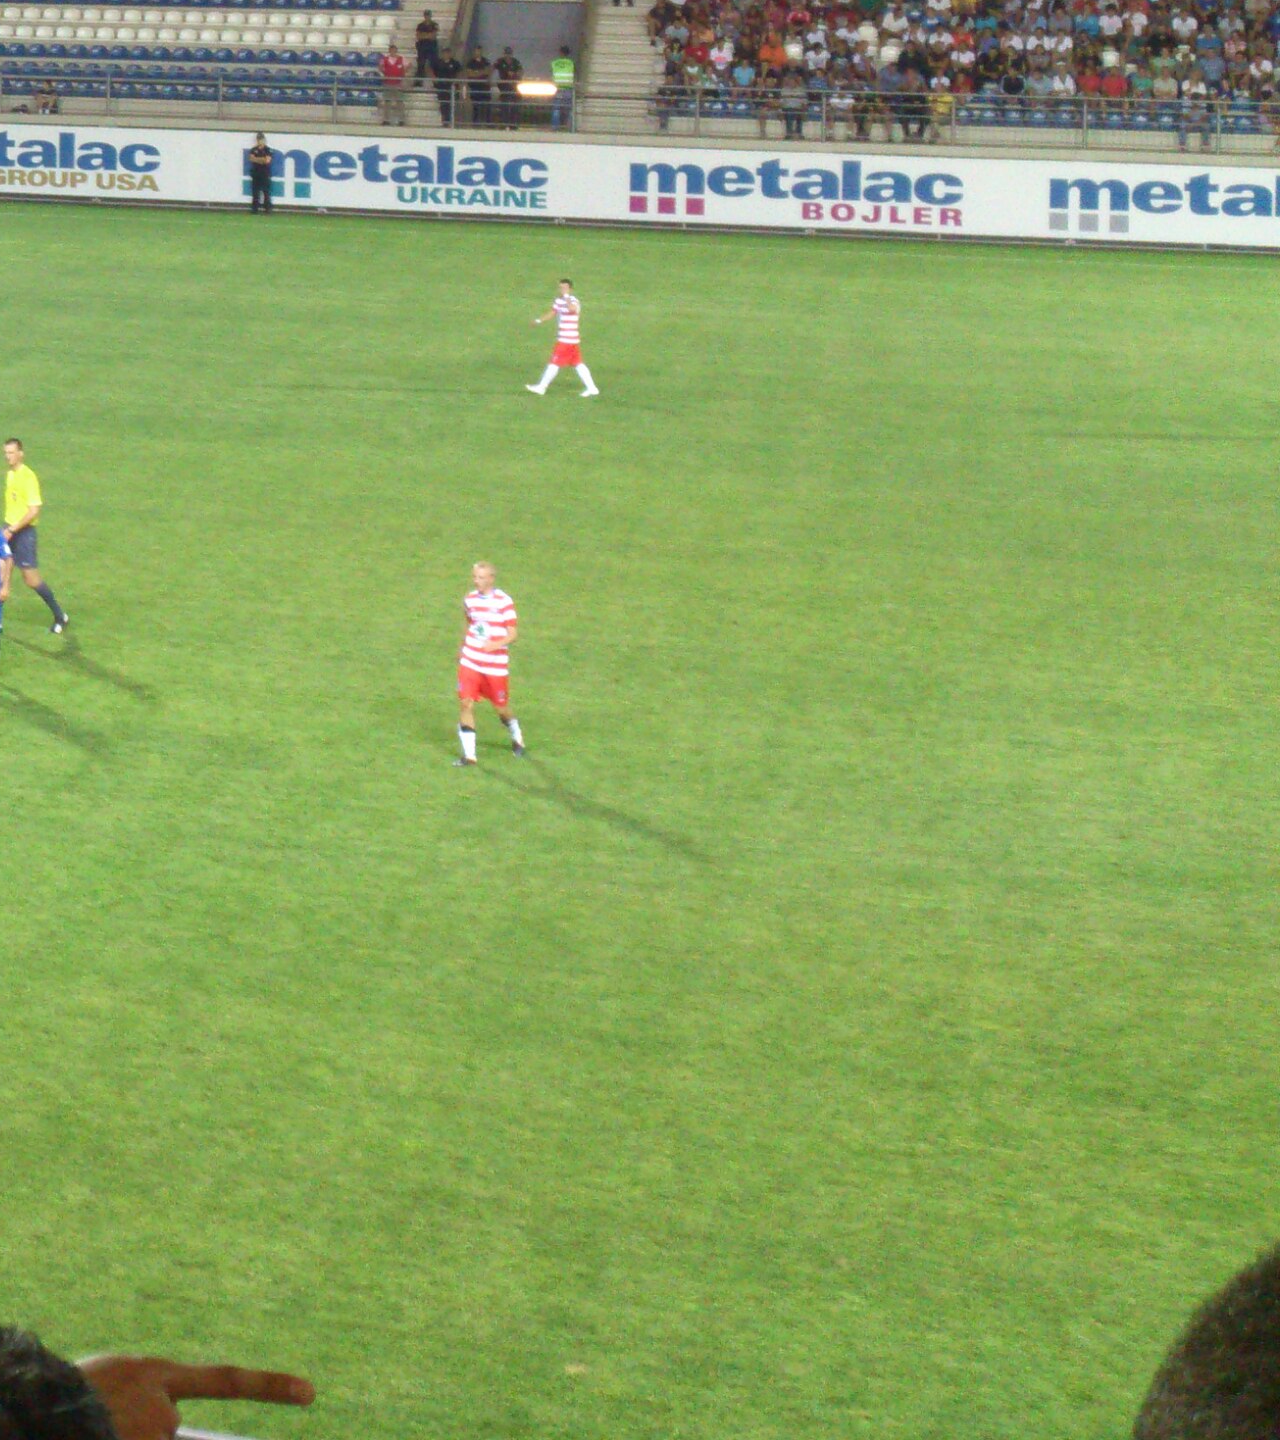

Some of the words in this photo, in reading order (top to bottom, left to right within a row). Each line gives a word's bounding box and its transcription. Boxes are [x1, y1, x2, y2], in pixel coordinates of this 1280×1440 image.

[96, 172, 160, 192] USA
[242, 144, 548, 189] metalac
[629, 158, 964, 205] metalac
[396, 185, 547, 209] UKRAINE
[1049, 173, 1280, 217] meta
[801, 201, 963, 227] BOJLER
